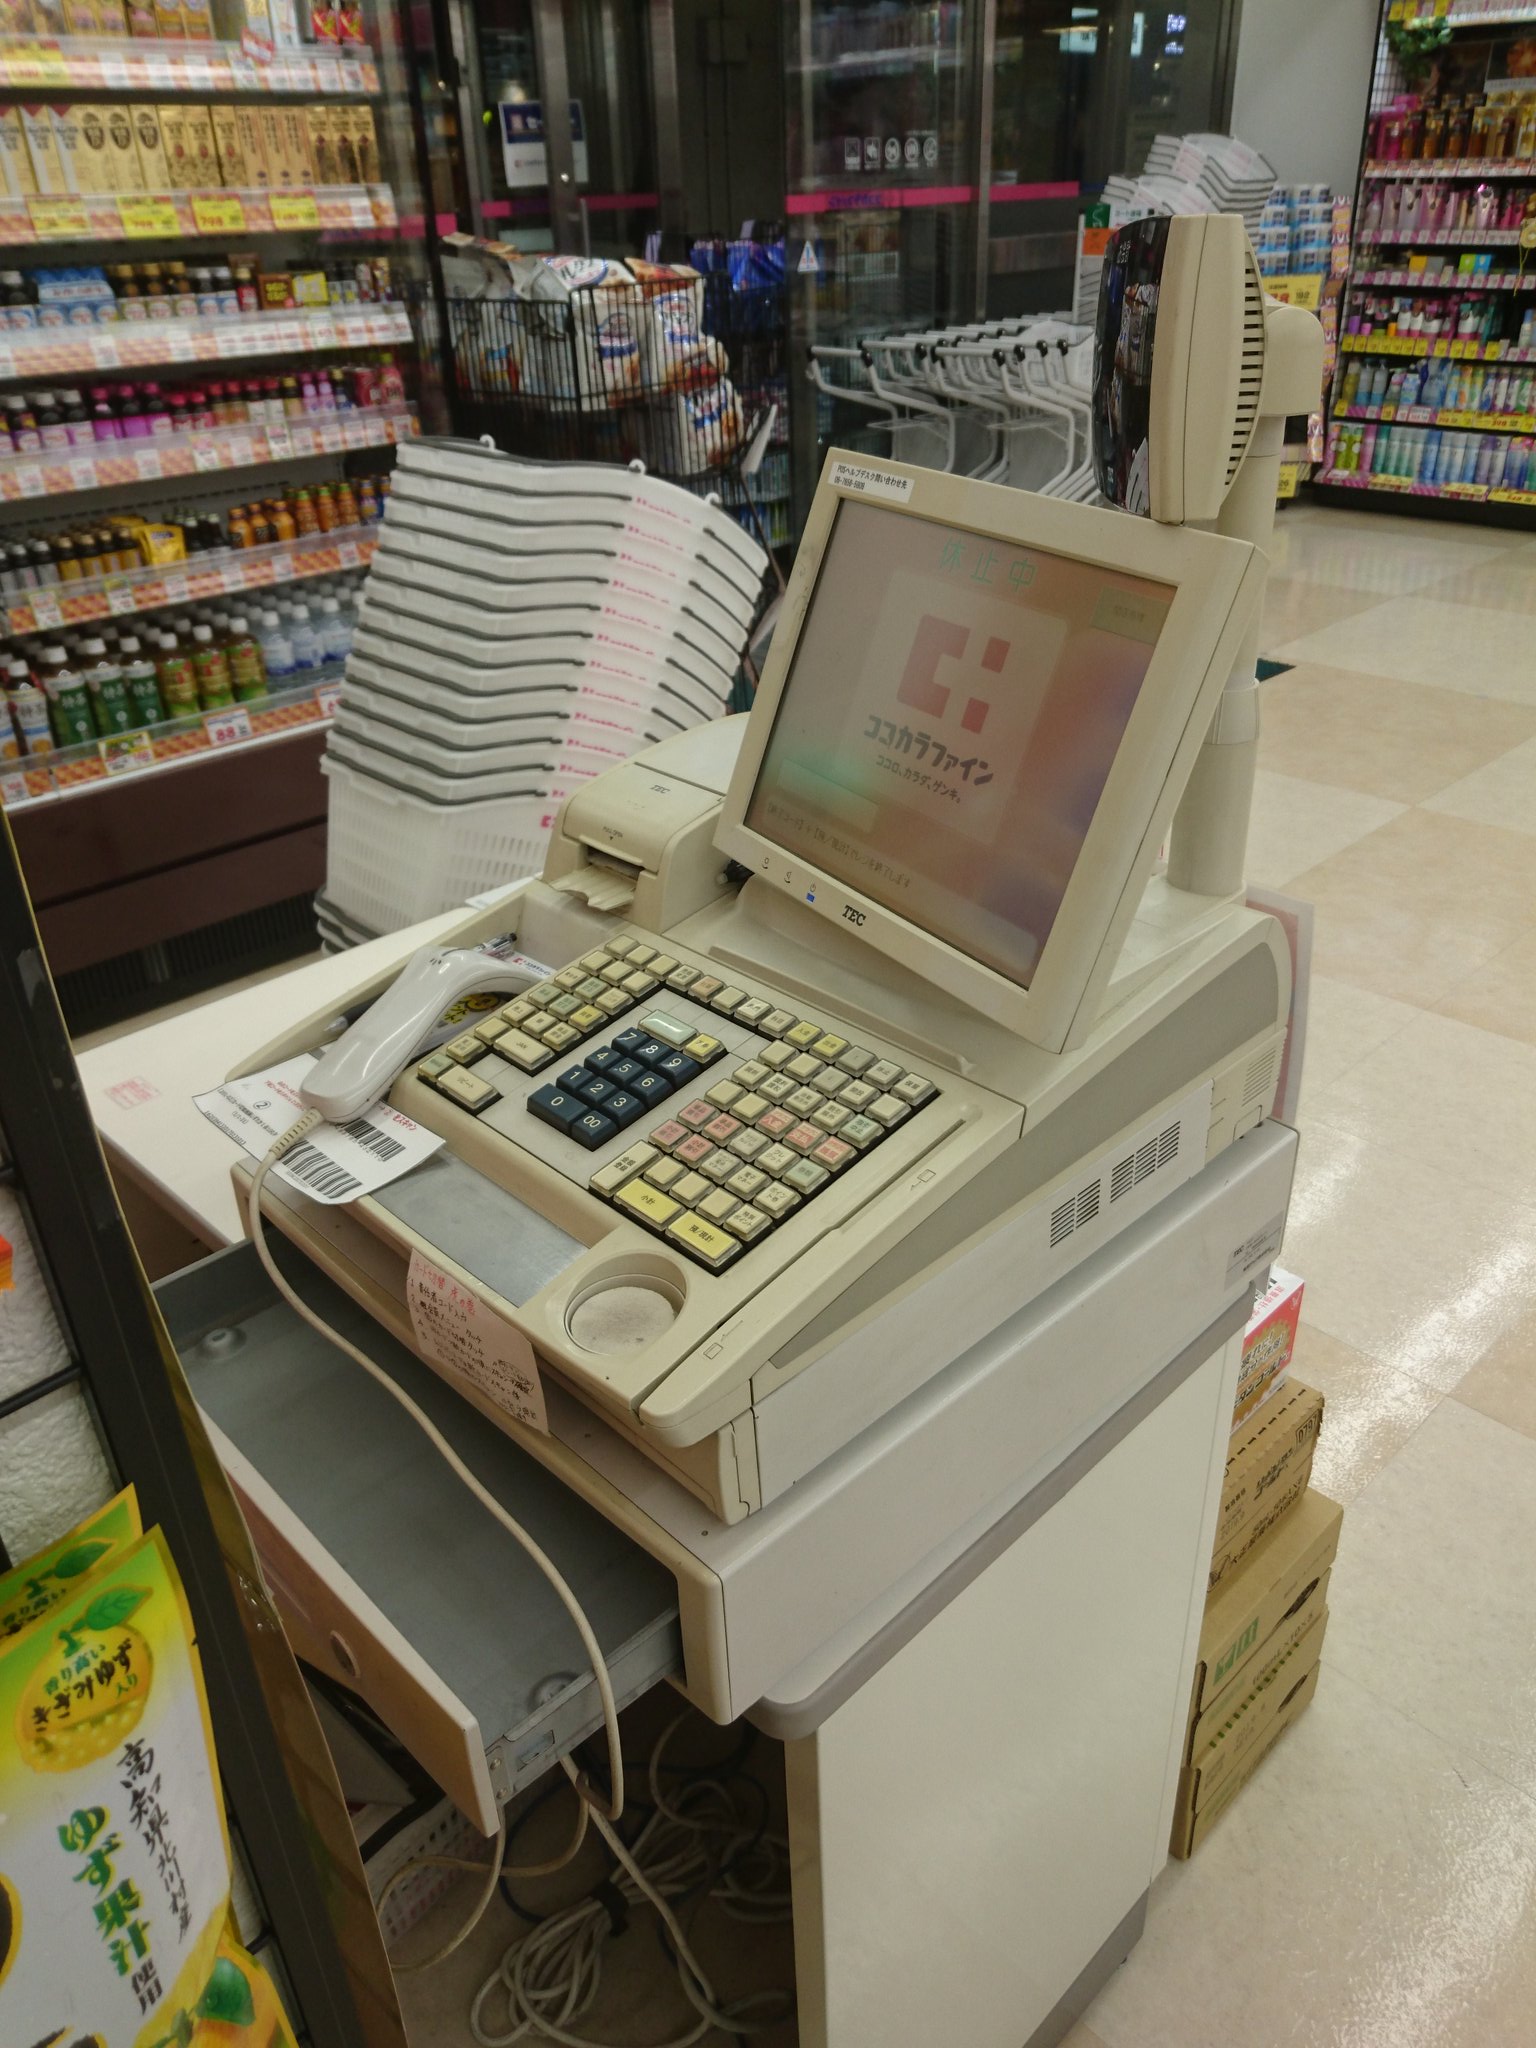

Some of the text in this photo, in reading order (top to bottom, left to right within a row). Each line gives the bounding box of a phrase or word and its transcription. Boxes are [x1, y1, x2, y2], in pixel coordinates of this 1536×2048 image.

[940, 538, 1037, 592] 休止中
[215, 726, 236, 742] 88
[863, 714, 994, 786] ココカラファイン
[875, 754, 962, 804] ココロ、カラダ、ゲンキ。
[842, 905, 867, 927] TEC
[597, 1051, 609, 1060] 4
[570, 1070, 582, 1080] 1
[619, 1063, 633, 1073] 5
[589, 1083, 604, 1094] 2
[641, 1077, 655, 1087] 6
[550, 1096, 564, 1106] 0
[613, 1096, 627, 1107] 3
[583, 1115, 601, 1129] 00
[621, 1155, 637, 1167] 金額
[640, 1194, 656, 1206] 小計
[688, 1223, 715, 1243] 預/現計
[43, 1644, 106, 1696] 香り高い
[32, 1637, 132, 1732] きざみゆず
[117, 1672, 138, 1698] 入り
[116, 1737, 193, 1945] 高知県北川村産
